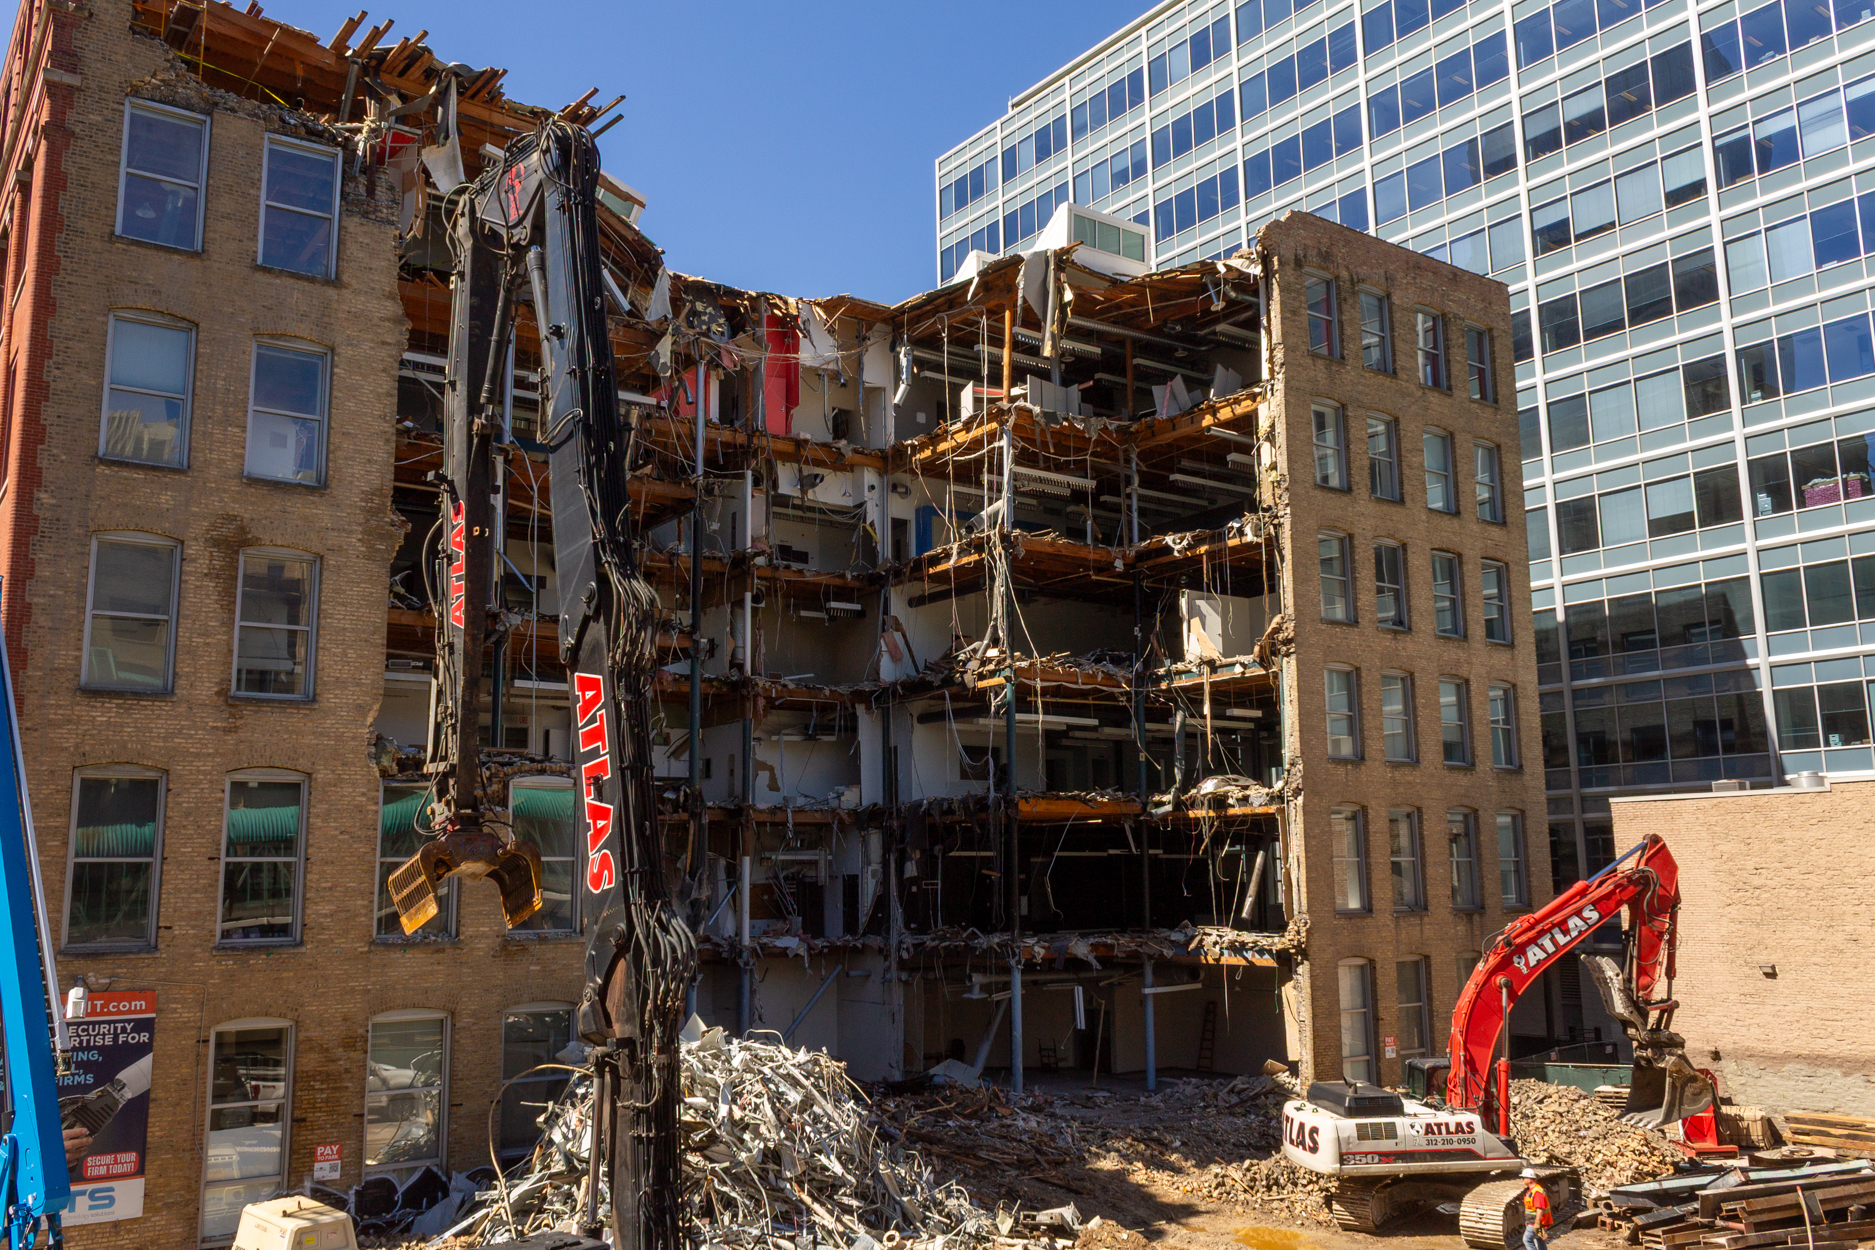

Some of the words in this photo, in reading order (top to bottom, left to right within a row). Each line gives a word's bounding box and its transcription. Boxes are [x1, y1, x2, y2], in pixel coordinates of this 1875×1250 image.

[451, 500, 465, 629] ATLAS
[574, 672, 615, 894] ATLAS
[1525, 904, 1602, 968] ATLAS
[62, 1000, 146, 1014] IT.com
[69, 1022, 134, 1036] ECURITY
[70, 1035, 113, 1047] RTISE
[118, 1033, 149, 1044] FOR
[56, 1073, 94, 1086] IRMS
[1283, 1111, 1320, 1155] TLAS
[1424, 1121, 1476, 1137] ATLAS
[1425, 1137, 1476, 1146] 312-210-0950
[317, 1145, 339, 1156] PAY
[87, 1155, 115, 1166] SECURE
[117, 1152, 136, 1163] YOUR
[87, 1166, 107, 1176] FIRM
[109, 1162, 134, 1174] TODAY!
[61, 1213, 90, 1222] echnology
[90, 1210, 116, 1218] solutions
